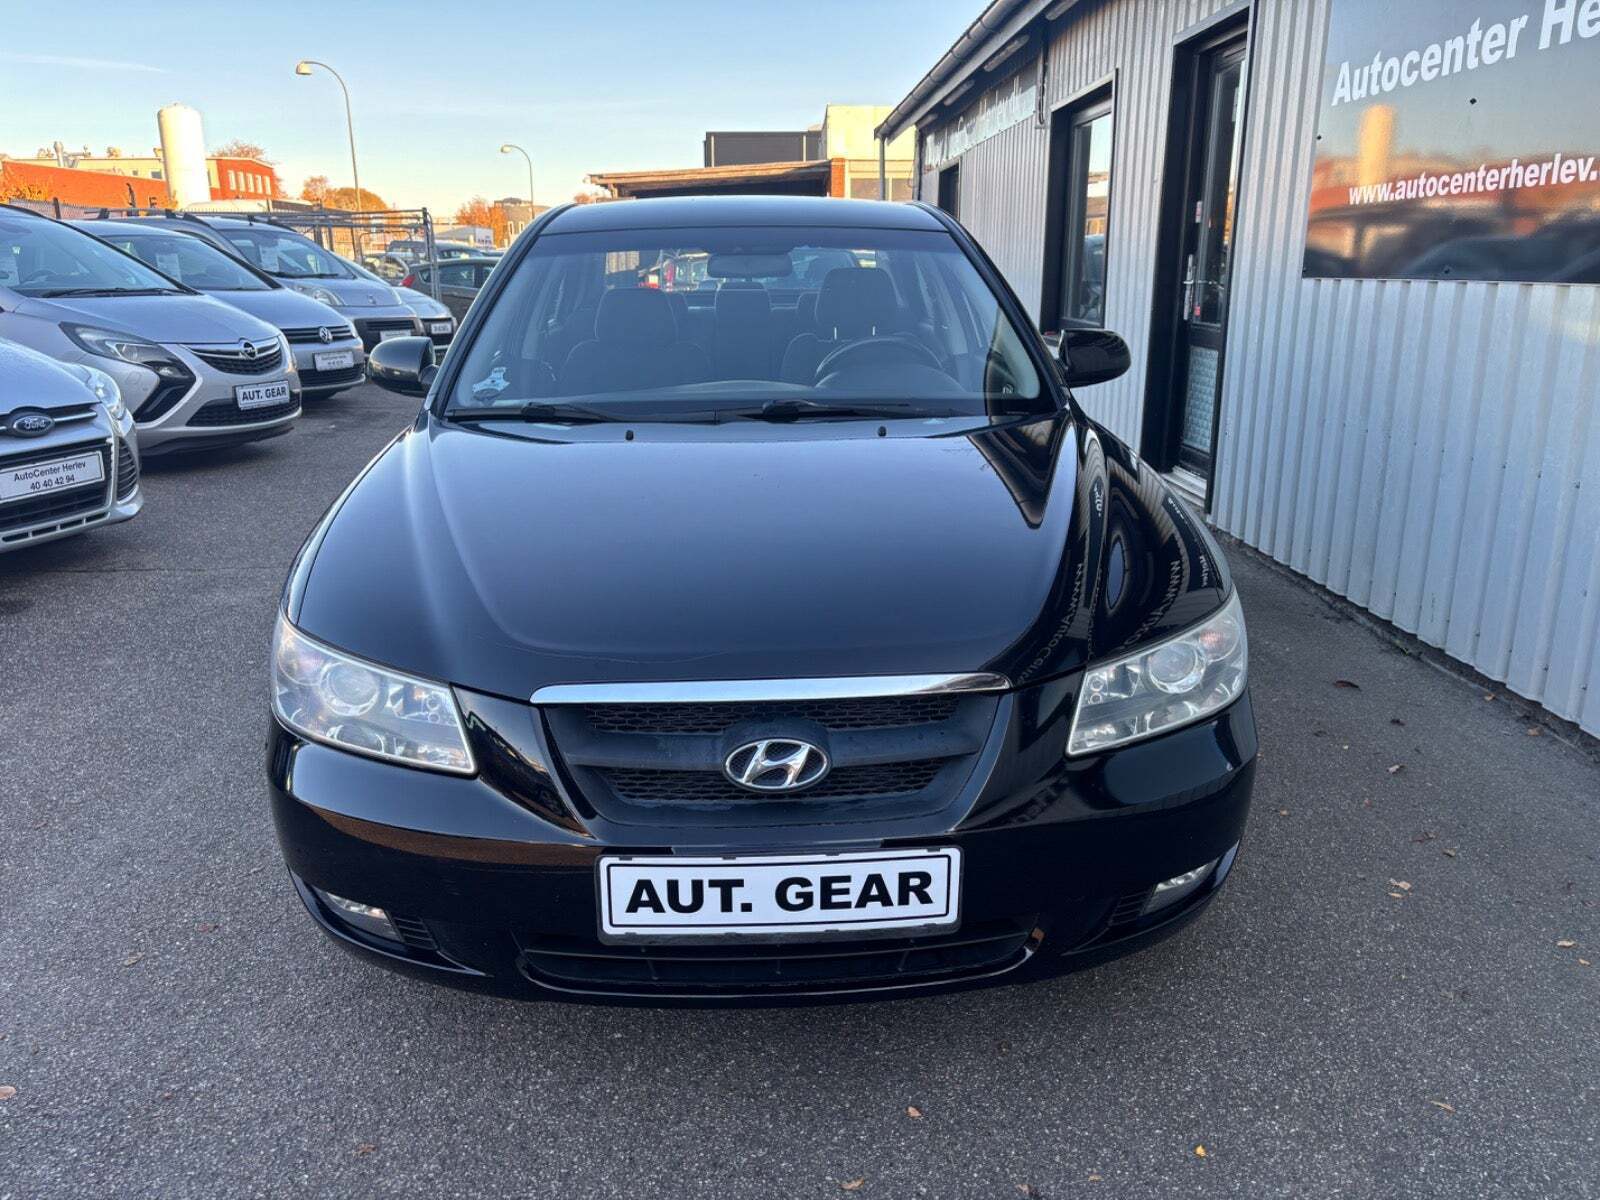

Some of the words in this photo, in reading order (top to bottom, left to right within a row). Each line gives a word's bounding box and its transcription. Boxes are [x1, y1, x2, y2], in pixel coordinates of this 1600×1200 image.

[1331, 15, 1529, 106] Autocenter
[242, 390, 263, 401] AUT.
[265, 386, 287, 398] GEAR
[14, 465, 61, 482] AutoCenter
[62, 460, 86, 471] Herlev
[30, 481, 41, 490] 40
[42, 479, 53, 488] 40
[54, 476, 65, 485] 42
[65, 474, 75, 483] 94
[625, 878, 753, 914] AUT.
[775, 871, 934, 912] GEAR
